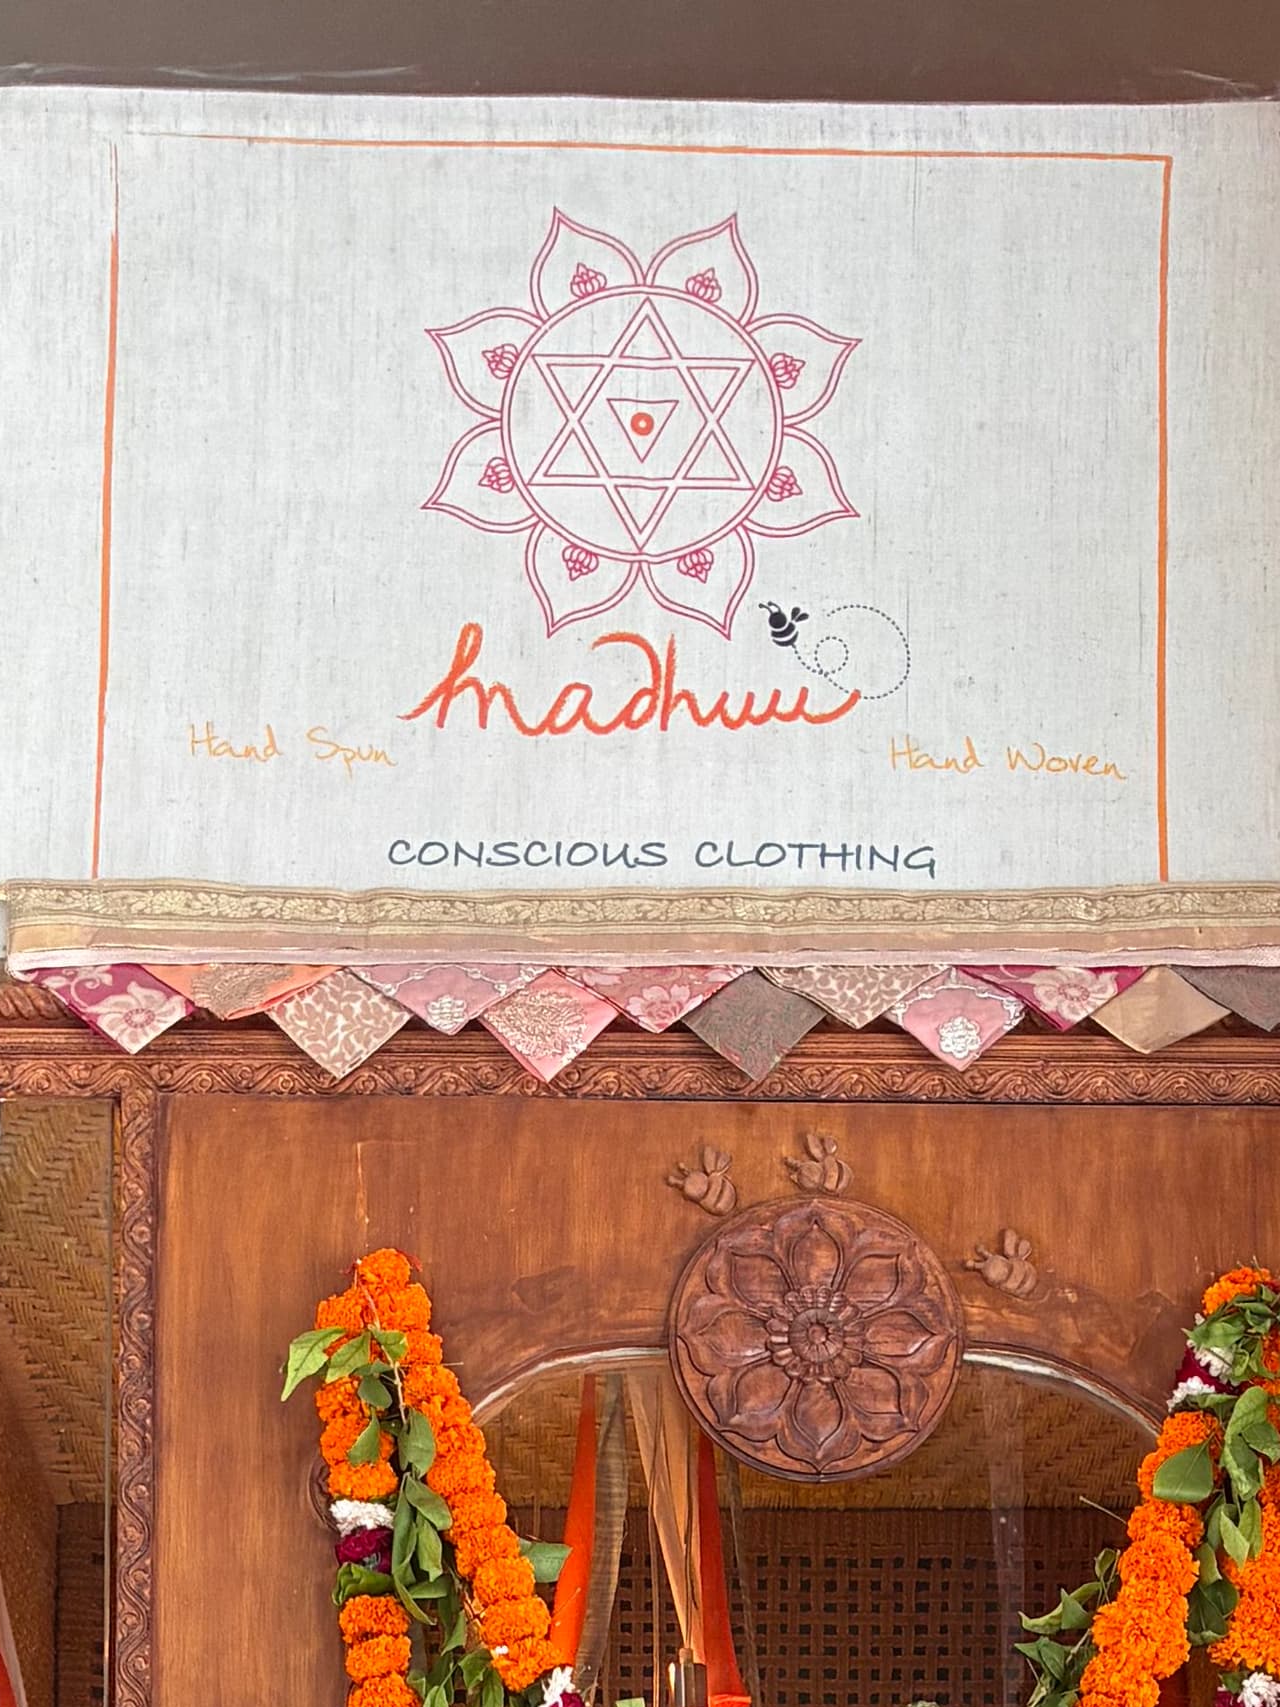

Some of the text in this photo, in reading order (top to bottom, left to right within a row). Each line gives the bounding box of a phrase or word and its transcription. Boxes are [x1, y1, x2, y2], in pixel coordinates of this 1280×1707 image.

[188, 721, 397, 780] Hand Spun
[889, 735, 1128, 781] Hand Woven
[387, 839, 936, 879] CONSCIOUS CLOTHING
